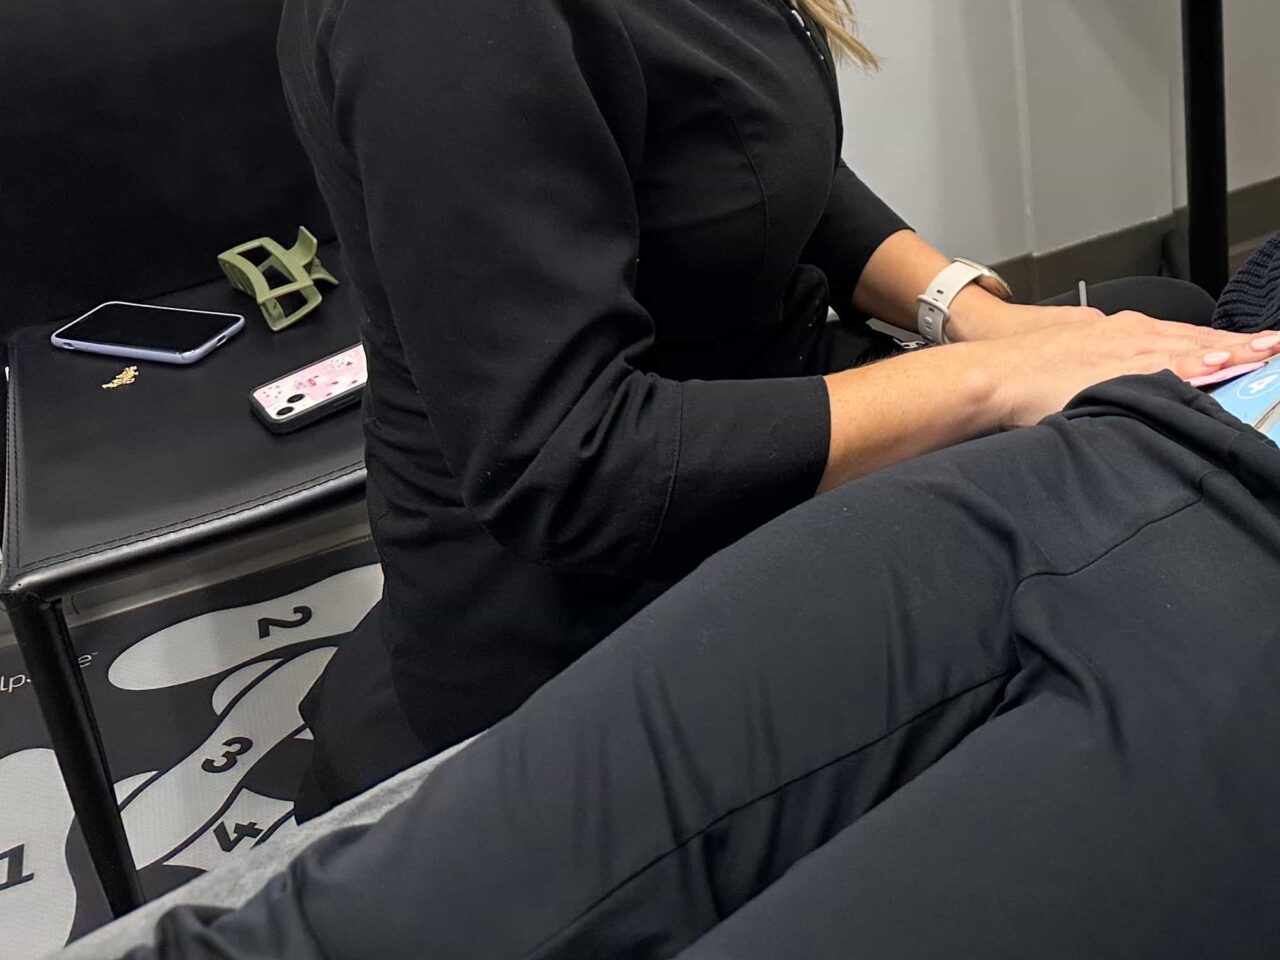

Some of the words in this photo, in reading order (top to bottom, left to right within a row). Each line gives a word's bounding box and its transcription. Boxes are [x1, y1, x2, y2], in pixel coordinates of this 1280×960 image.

[1247, 374, 1279, 394] 4
[257, 605, 312, 639] 2
[201, 736, 253, 773] 3
[213, 820, 264, 852] 4
[0, 843, 34, 890] 1
